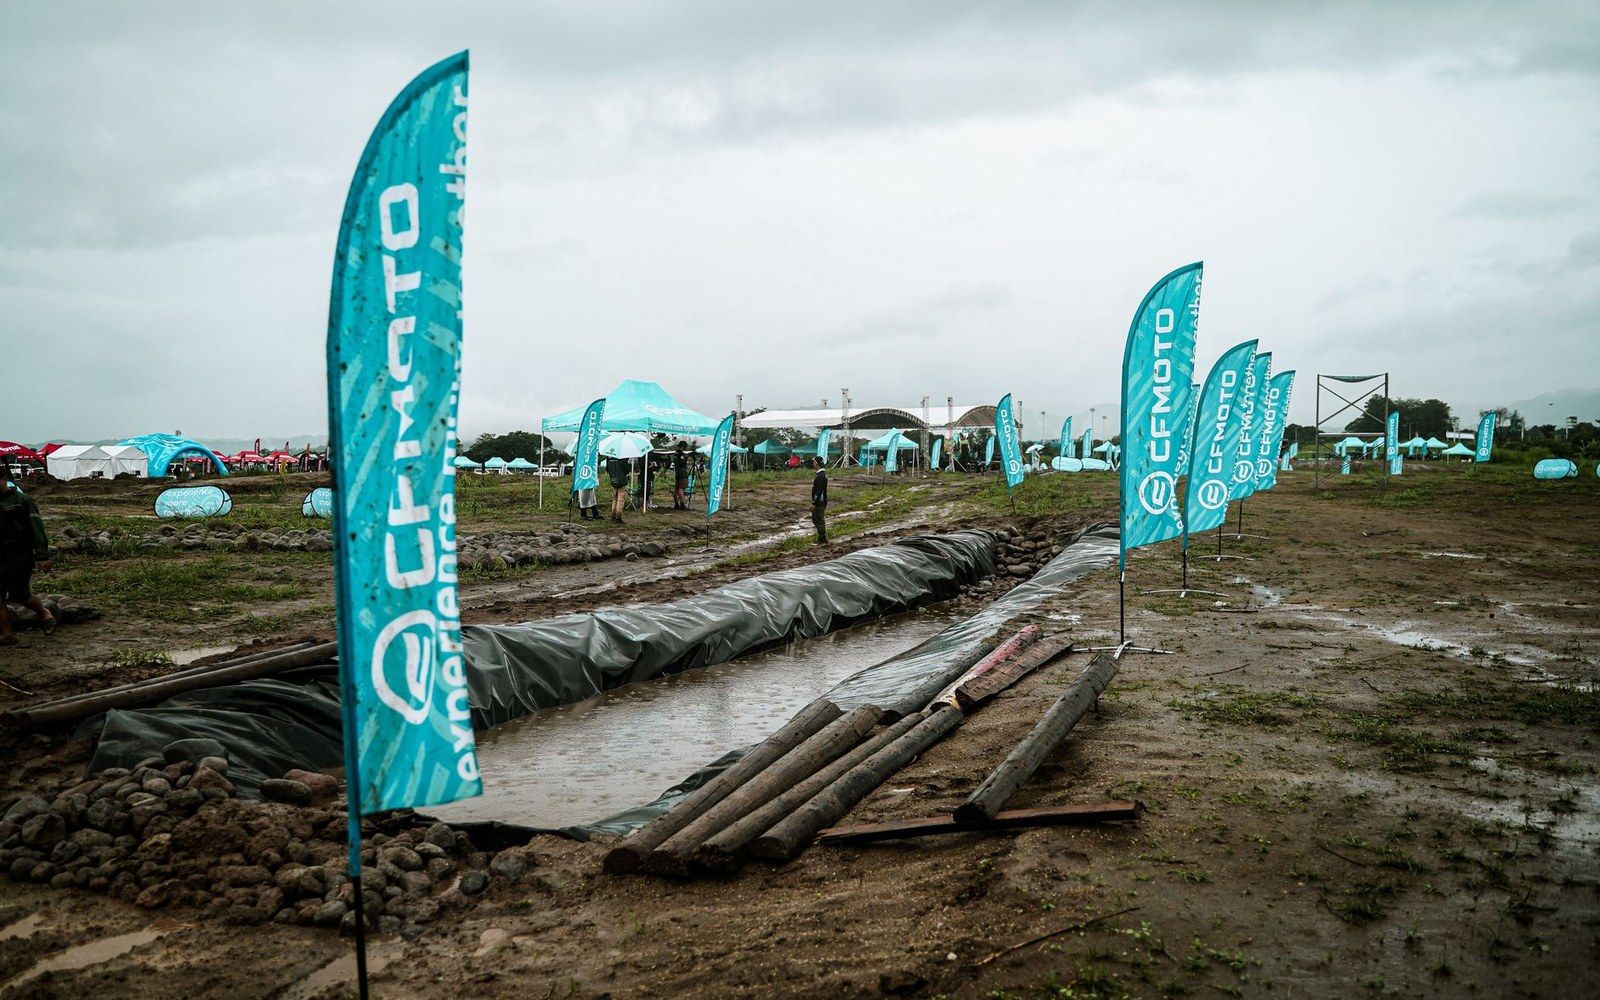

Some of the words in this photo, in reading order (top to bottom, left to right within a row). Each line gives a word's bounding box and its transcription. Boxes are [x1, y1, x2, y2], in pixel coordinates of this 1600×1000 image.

[1149, 308, 1174, 462] CFMOTO
[1208, 369, 1237, 474] CFMOTO
[1260, 388, 1280, 456] CFMOTO
